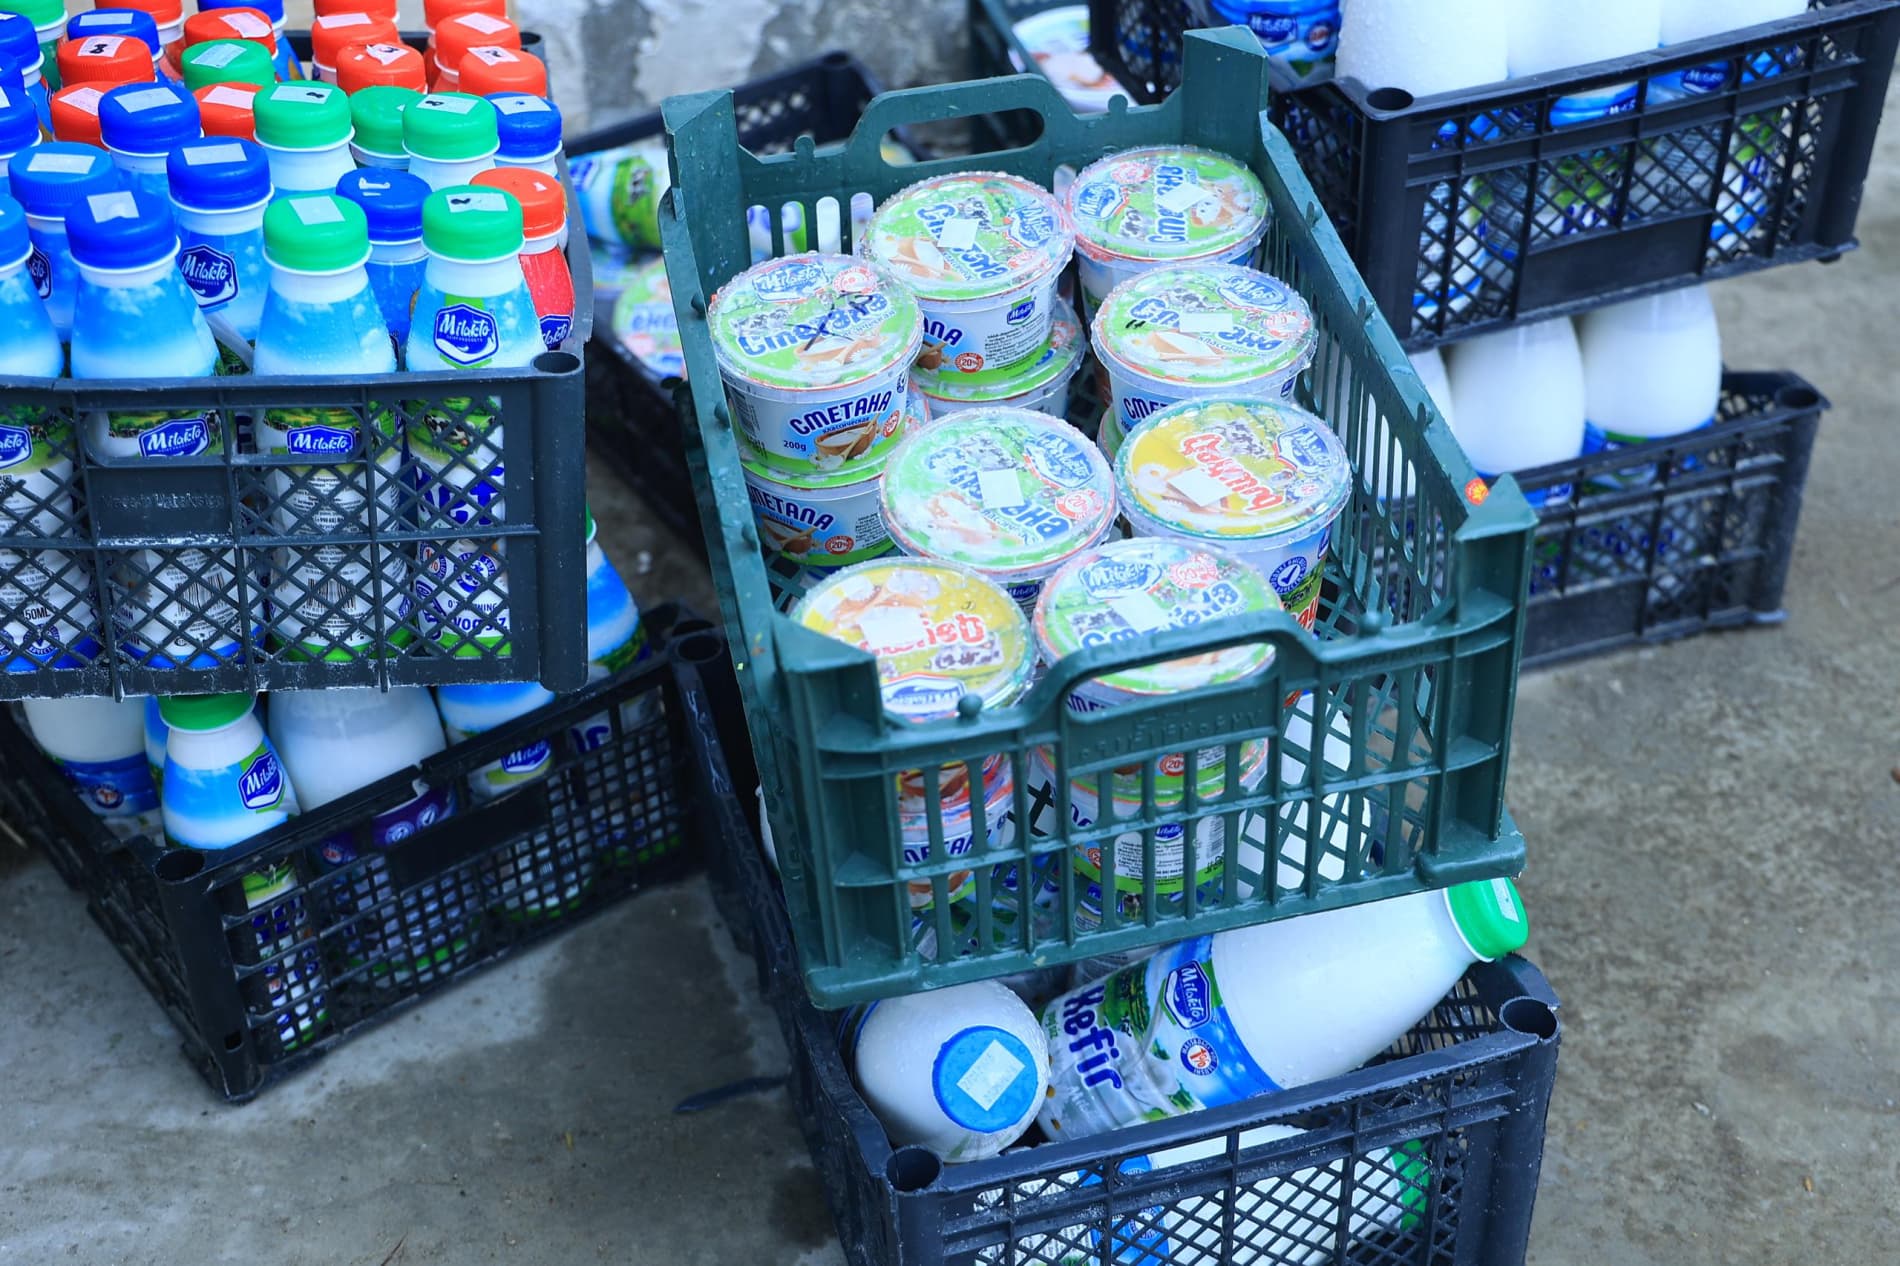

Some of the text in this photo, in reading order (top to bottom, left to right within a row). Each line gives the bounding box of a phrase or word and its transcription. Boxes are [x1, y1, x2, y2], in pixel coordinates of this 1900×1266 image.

[181, 254, 229, 280] Milakto
[439, 314, 490, 337] Milakto
[789, 390, 893, 435] СМЕТАНА
[148, 424, 201, 450] Milakto
[293, 433, 348, 450] Milakto
[783, 440, 807, 452] 200g
[1181, 966, 1205, 1020] Milakto
[1063, 985, 1122, 1089] Kefir
